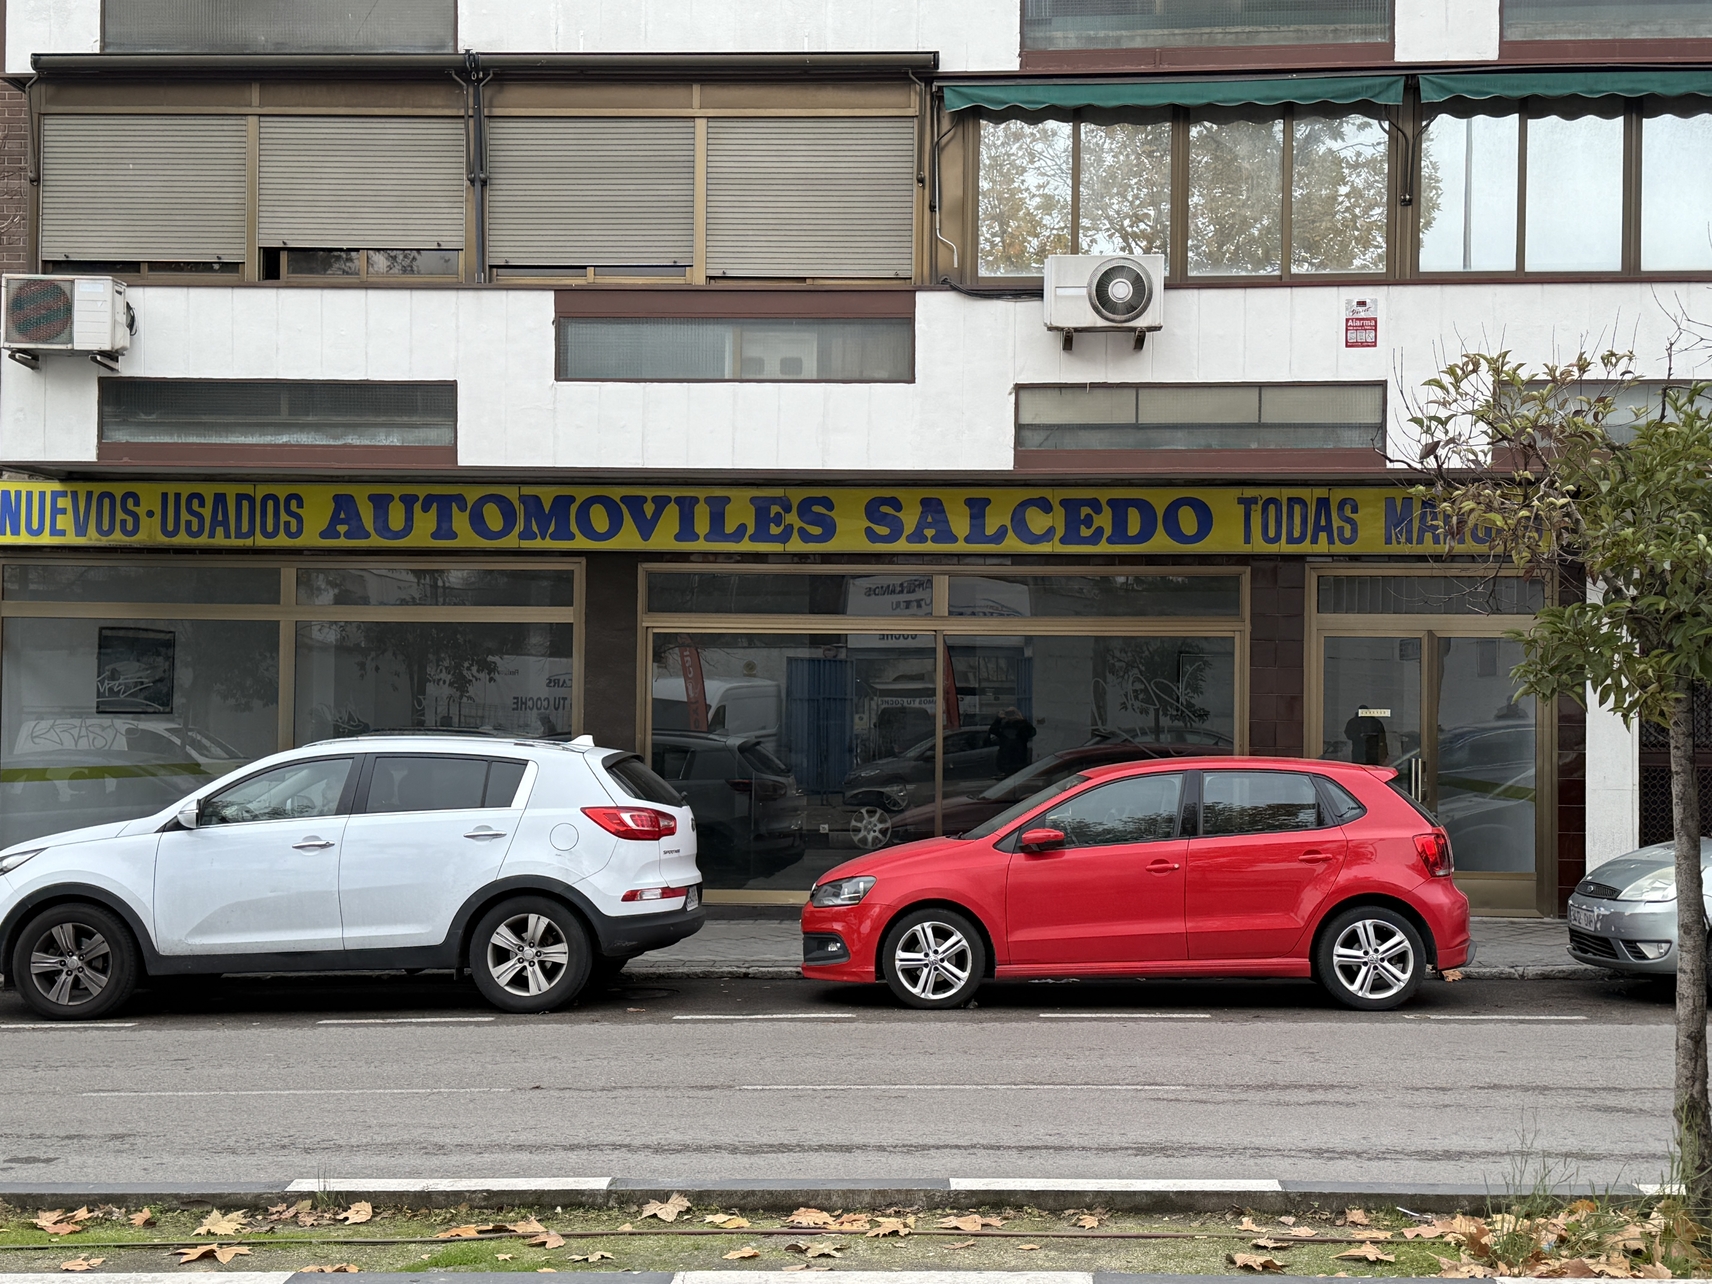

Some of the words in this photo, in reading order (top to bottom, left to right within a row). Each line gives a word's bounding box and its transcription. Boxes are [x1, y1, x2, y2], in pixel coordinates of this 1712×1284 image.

[1347, 319, 1376, 327] Alarma
[318, 493, 838, 544] AUTOMOVILES
[863, 496, 1214, 546] SALCEDO
[1237, 496, 1359, 546] TODAS
